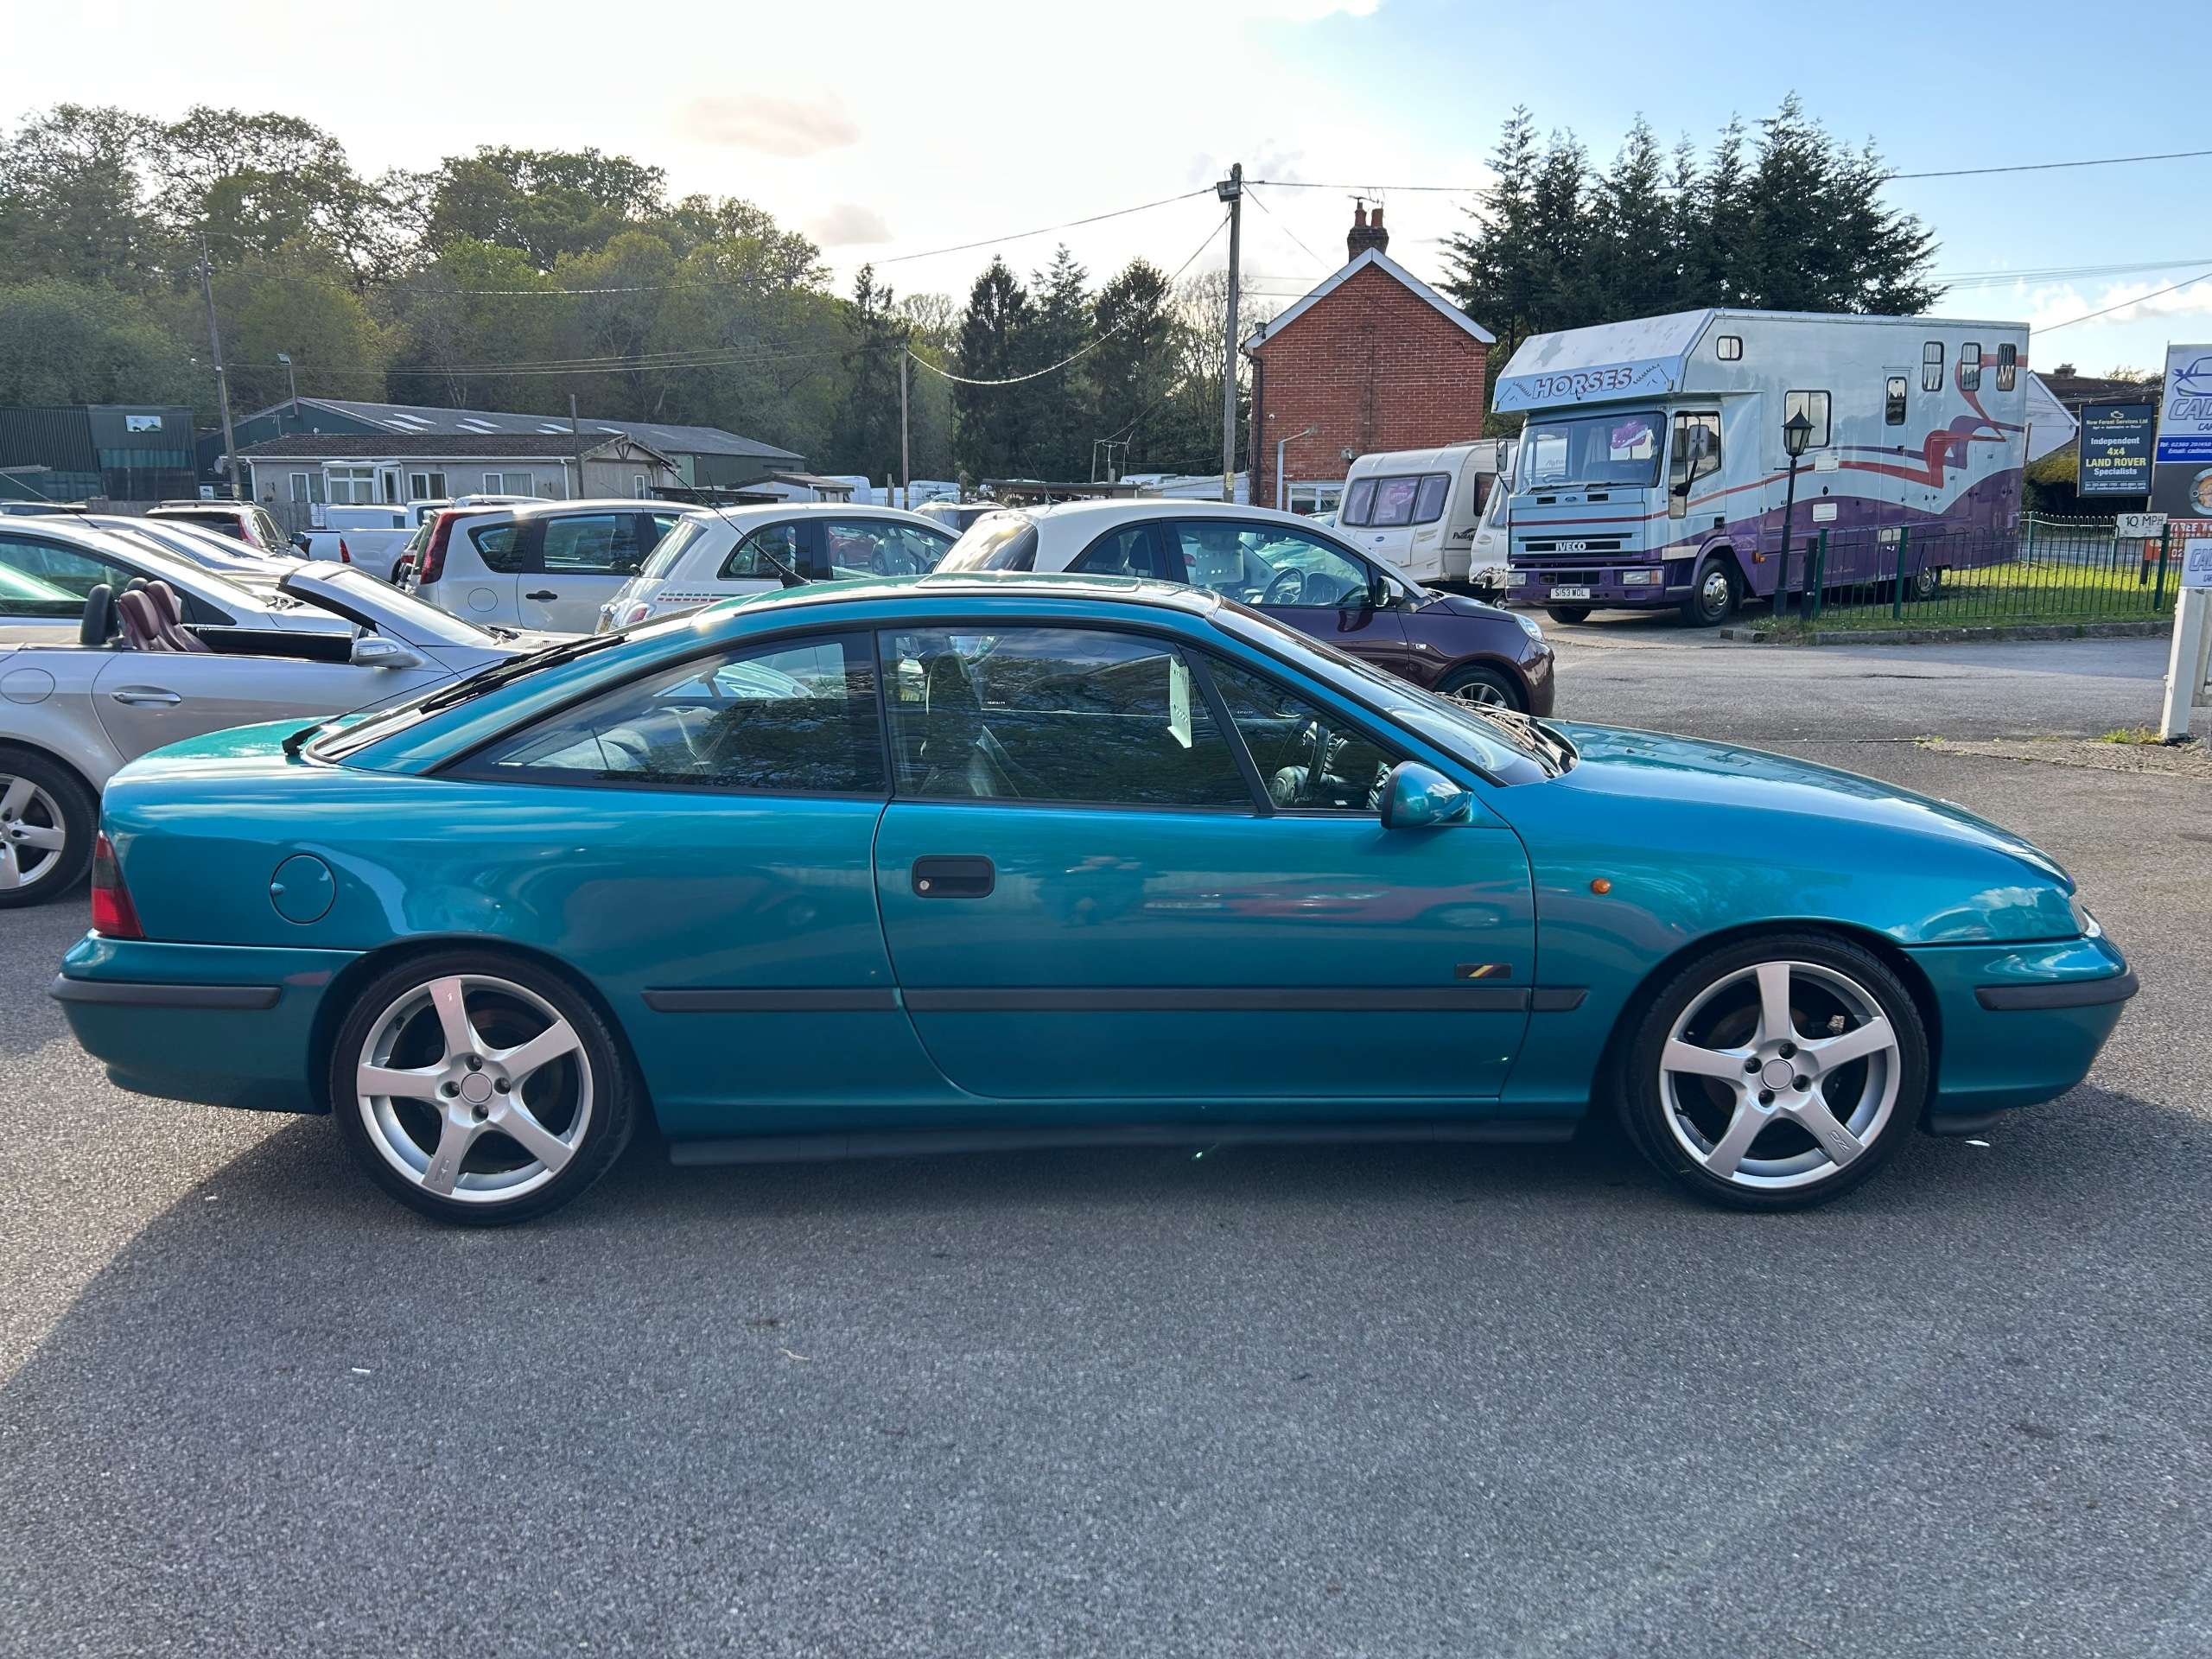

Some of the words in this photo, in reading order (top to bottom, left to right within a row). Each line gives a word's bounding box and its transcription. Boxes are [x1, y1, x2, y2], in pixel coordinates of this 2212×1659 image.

[1532, 368, 1633, 398] HORSES
[2090, 436, 2140, 446] Independent
[2107, 447, 2126, 455] 4x4
[2086, 459, 2112, 467] LAND
[2113, 458, 2146, 467] ROVER
[2094, 467, 2138, 477] Specialists
[2126, 516, 2139, 527] 10
[2142, 516, 2164, 526] MPH
[1555, 542, 1586, 551] IVECO
